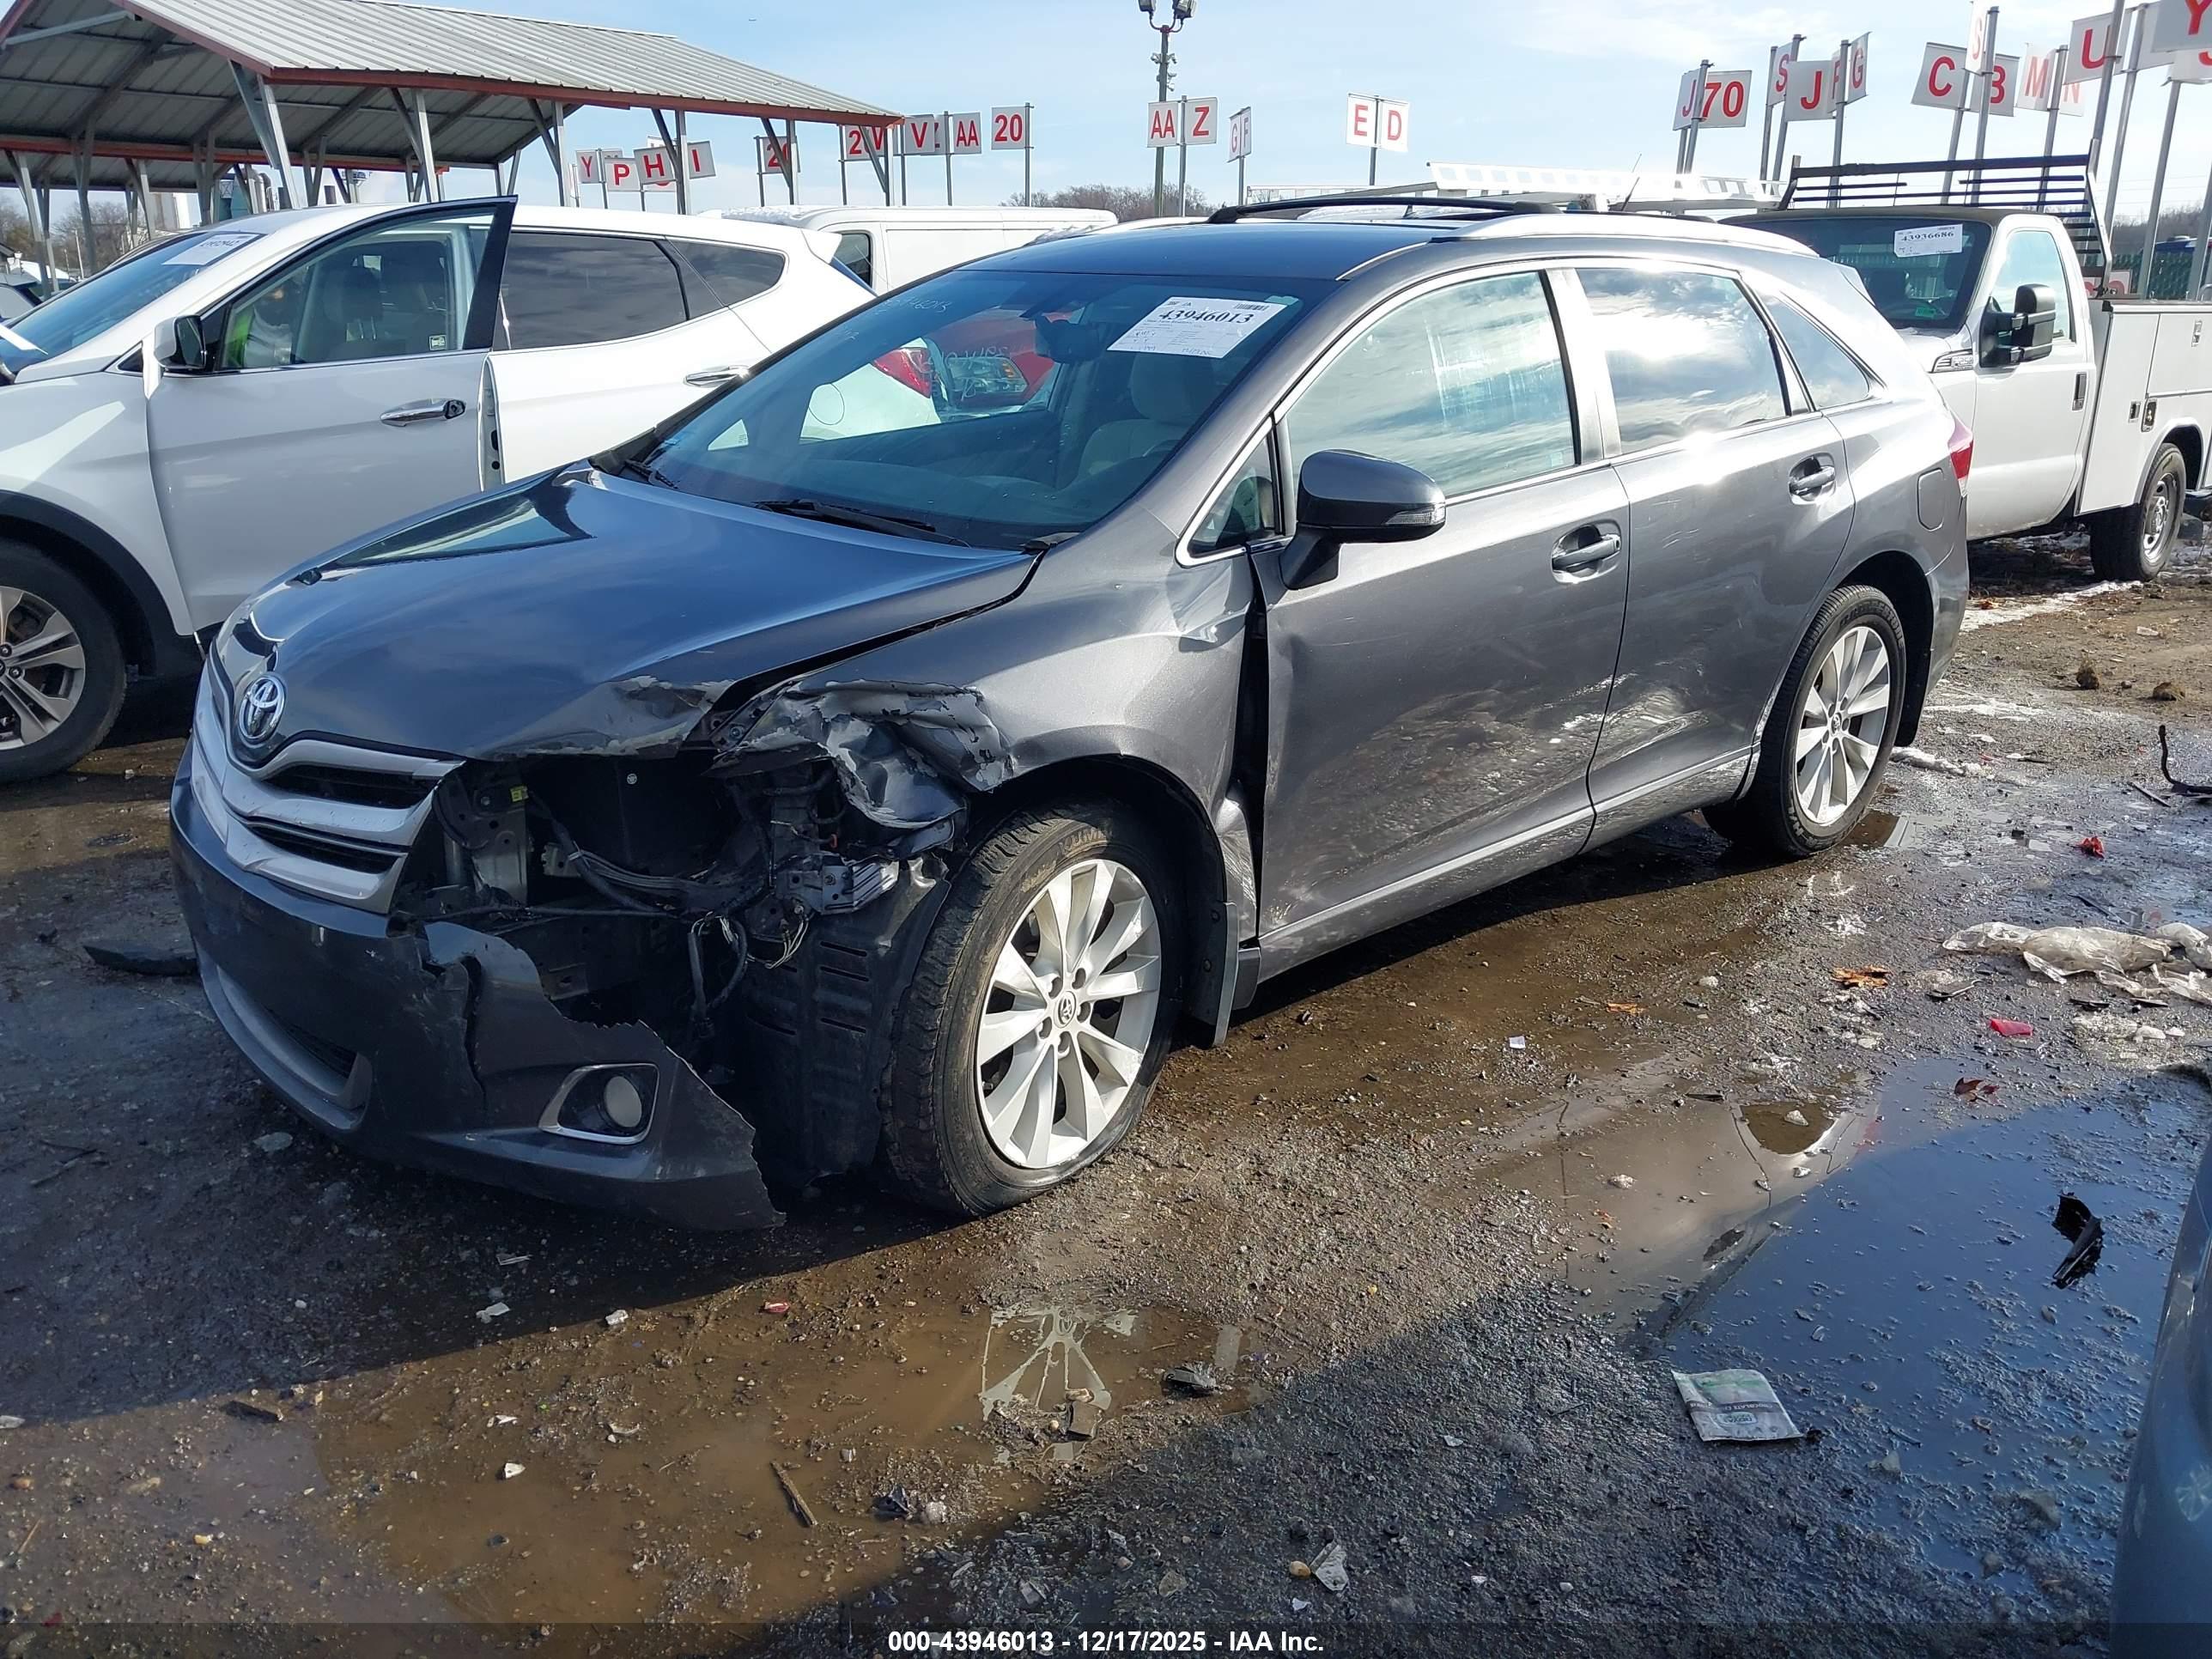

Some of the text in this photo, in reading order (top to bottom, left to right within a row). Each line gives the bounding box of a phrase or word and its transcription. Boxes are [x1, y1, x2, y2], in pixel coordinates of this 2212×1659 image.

[2081, 26, 2111, 69] U
[1776, 53, 1790, 92] S
[1852, 48, 1863, 88] G
[1929, 56, 1954, 97] C
[2026, 57, 2048, 98] M
[1683, 79, 1696, 117] J
[1702, 81, 1744, 118] 70
[1800, 70, 1822, 110] J
[911, 122, 927, 148] V
[957, 120, 979, 148] AA
[994, 113, 1022, 143] 20
[1151, 110, 1175, 139] AA
[1194, 106, 1209, 136] Z
[1243, 118, 1250, 148] F
[1354, 105, 1367, 136] E
[1388, 110, 1401, 141] D
[1231, 126, 1238, 153] G
[581, 156, 592, 177] Y
[614, 164, 629, 185] P
[643, 154, 664, 178] H
[692, 149, 700, 172] I
[1900, 231, 1954, 241] 43936686
[1159, 309, 1255, 324] 43946013
